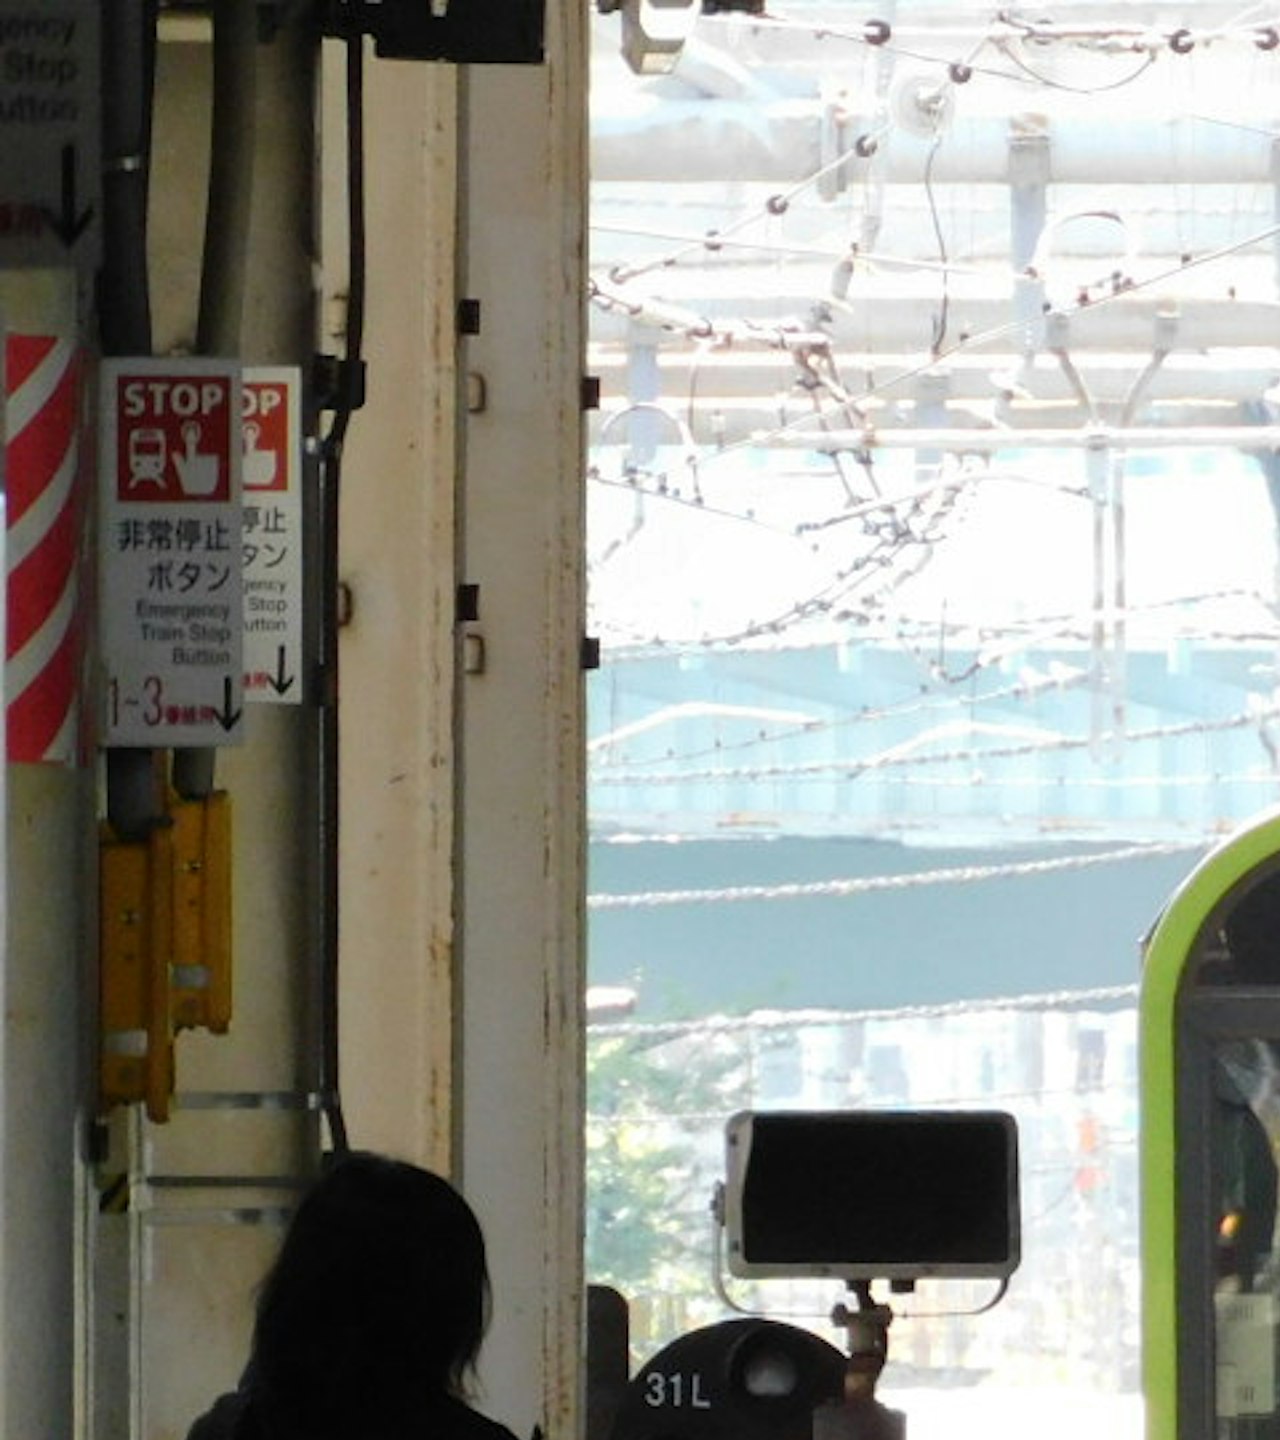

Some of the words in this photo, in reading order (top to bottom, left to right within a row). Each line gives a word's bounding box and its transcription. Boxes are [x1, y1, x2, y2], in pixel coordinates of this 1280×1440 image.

[125, 384, 223, 415] STOP
[119, 518, 229, 550] 非常停止
[149, 561, 230, 592] ボタン
[136, 601, 230, 621] Emergency
[248, 597, 288, 614] Stop
[141, 623, 185, 641] Train
[189, 623, 232, 645] Stop
[172, 647, 231, 664] Button
[645, 1373, 711, 1408] 31L
